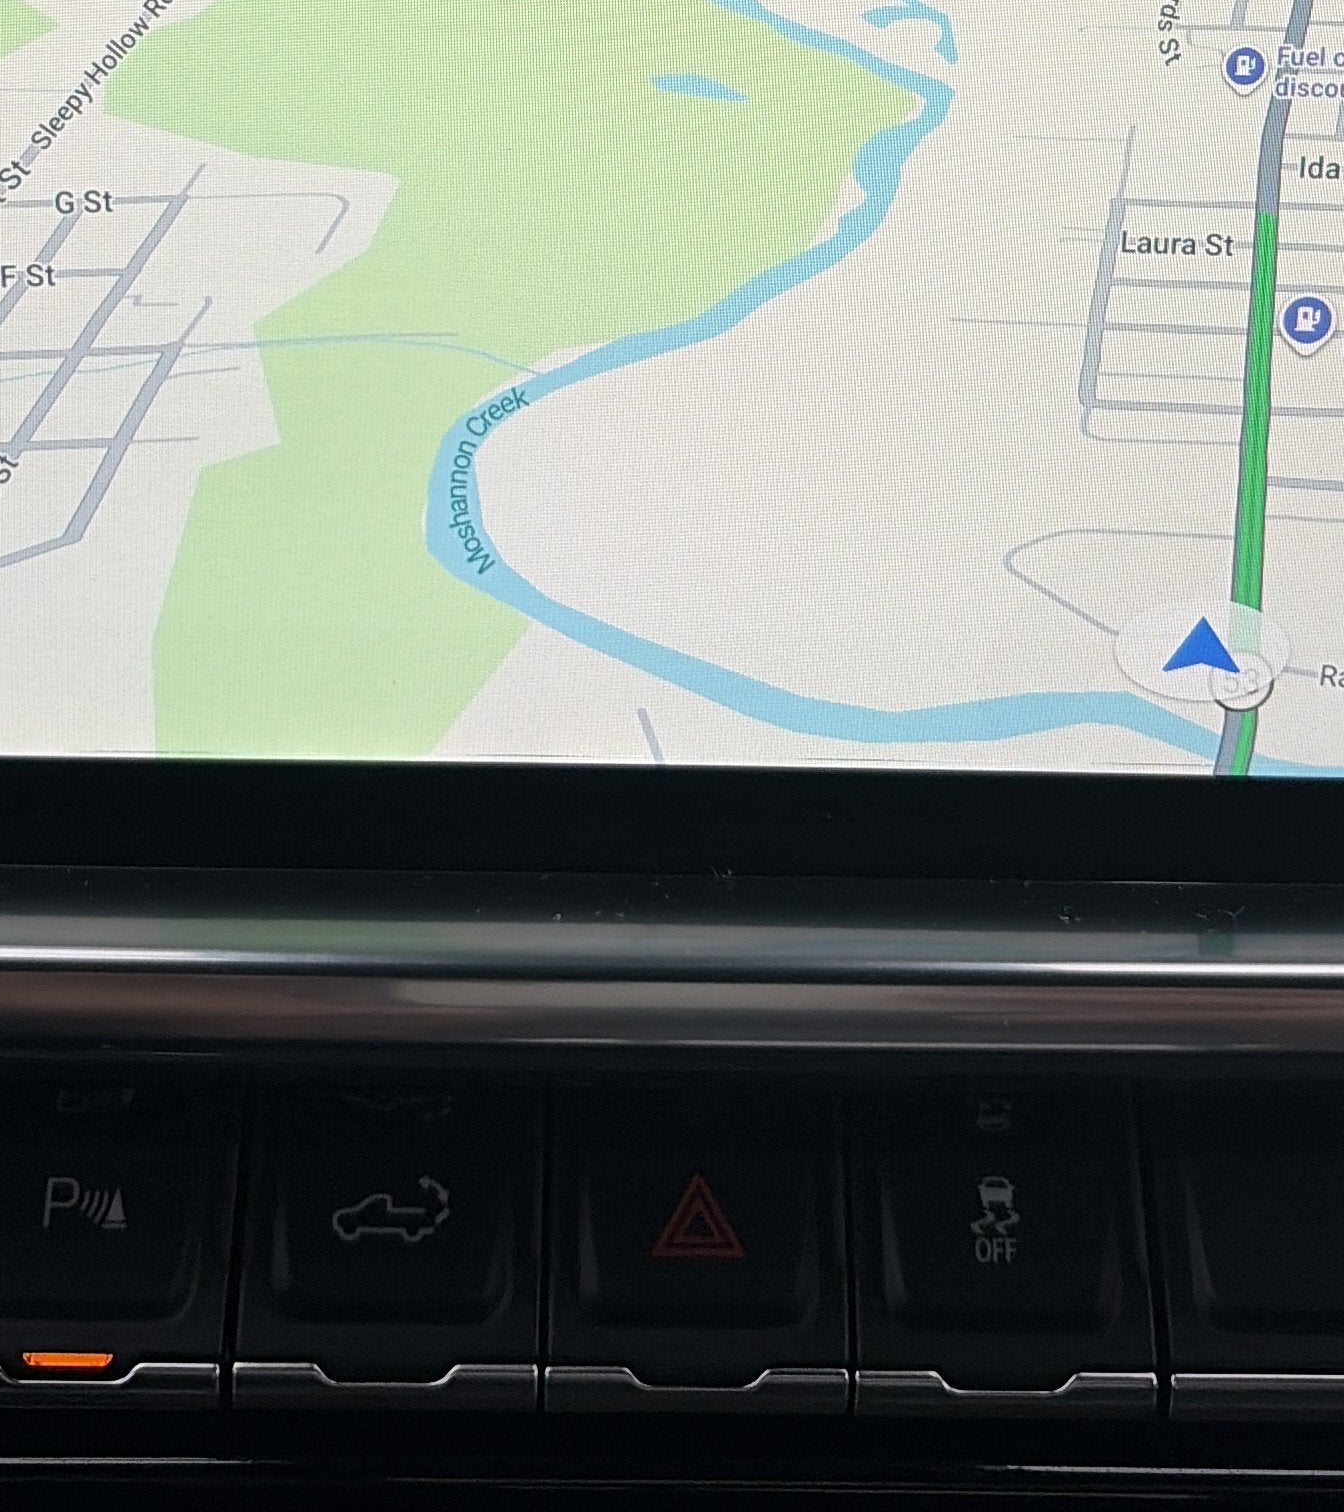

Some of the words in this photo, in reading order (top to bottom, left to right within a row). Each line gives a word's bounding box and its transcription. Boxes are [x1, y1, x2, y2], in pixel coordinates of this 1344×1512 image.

[1159, 37, 1182, 66] St
[1277, 47, 1325, 71] Fuel
[31, 82, 94, 151] Sleepy
[85, 15, 151, 84] Hollow
[0, 159, 31, 191] St
[1299, 155, 1344, 180] Ida
[55, 192, 75, 213] G
[83, 191, 113, 213] St
[1121, 233, 1197, 255] Laura
[1206, 233, 1234, 256] St
[0, 267, 17, 288] F
[26, 265, 55, 288] St
[466, 387, 530, 438] Creek
[448, 439, 496, 577] Moshannon
[975, 1237, 1017, 1263] OFF
